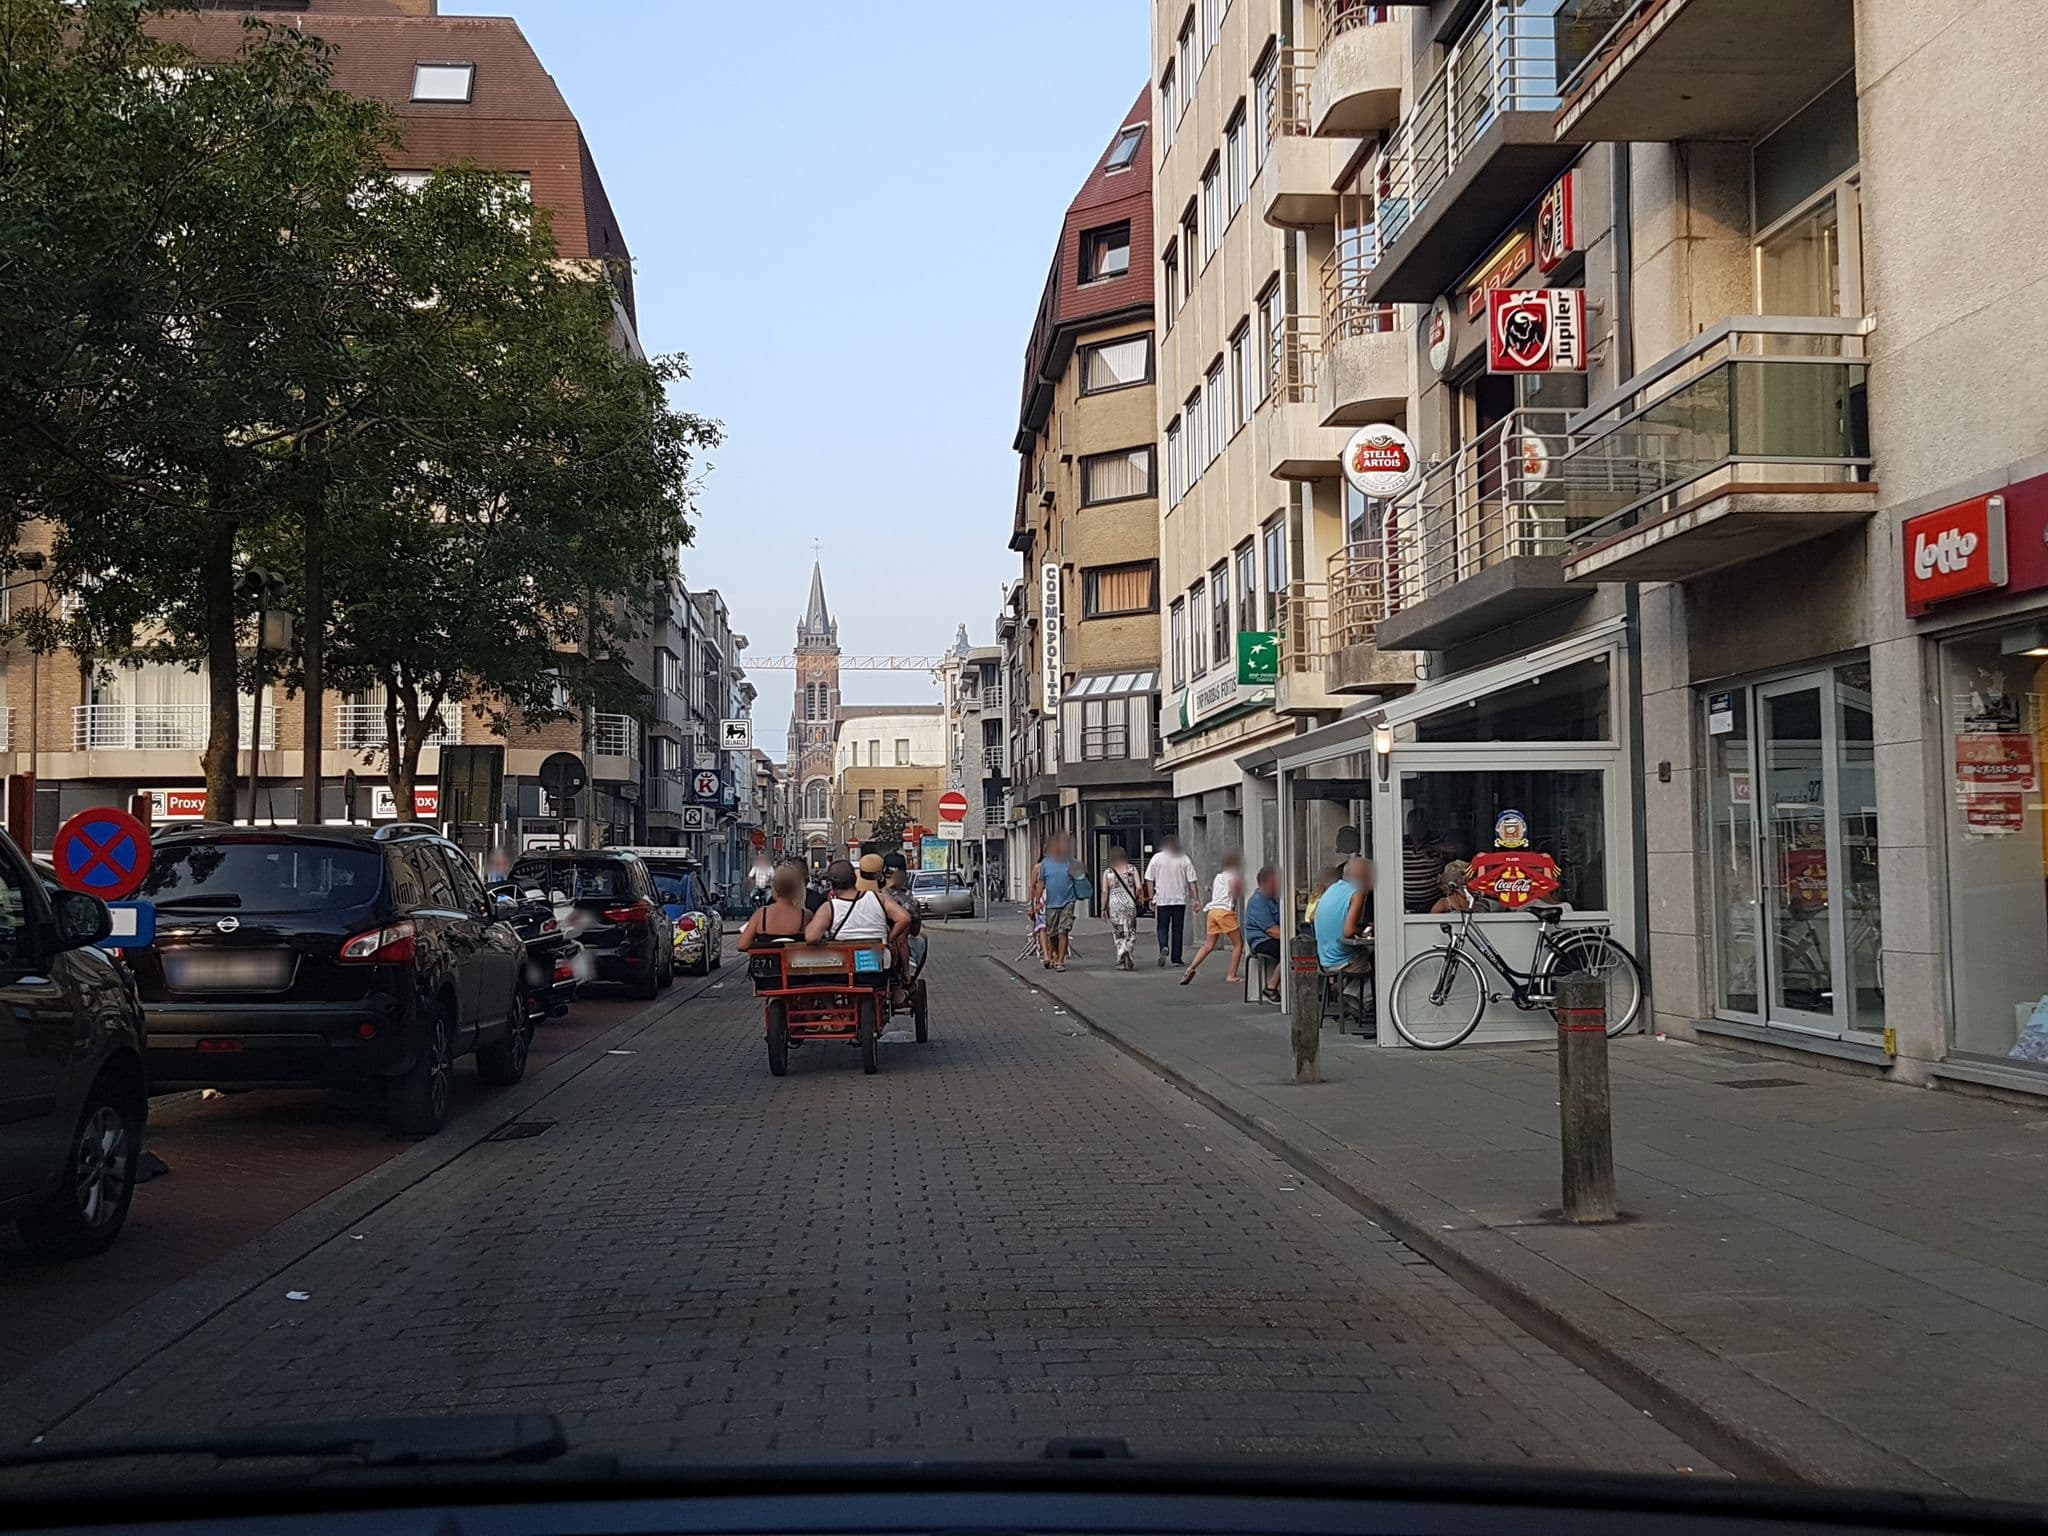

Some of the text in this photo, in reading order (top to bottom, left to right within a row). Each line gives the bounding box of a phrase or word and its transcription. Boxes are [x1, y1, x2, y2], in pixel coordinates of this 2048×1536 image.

[1468, 247, 1527, 316] Plaza
[1555, 290, 1577, 366] Jupiler
[1363, 450, 1399, 458] STELLA
[1363, 458, 1401, 467] ARTOIS
[1044, 567, 1058, 709] COSMOPOLITE
[170, 796, 206, 811] Proxy
